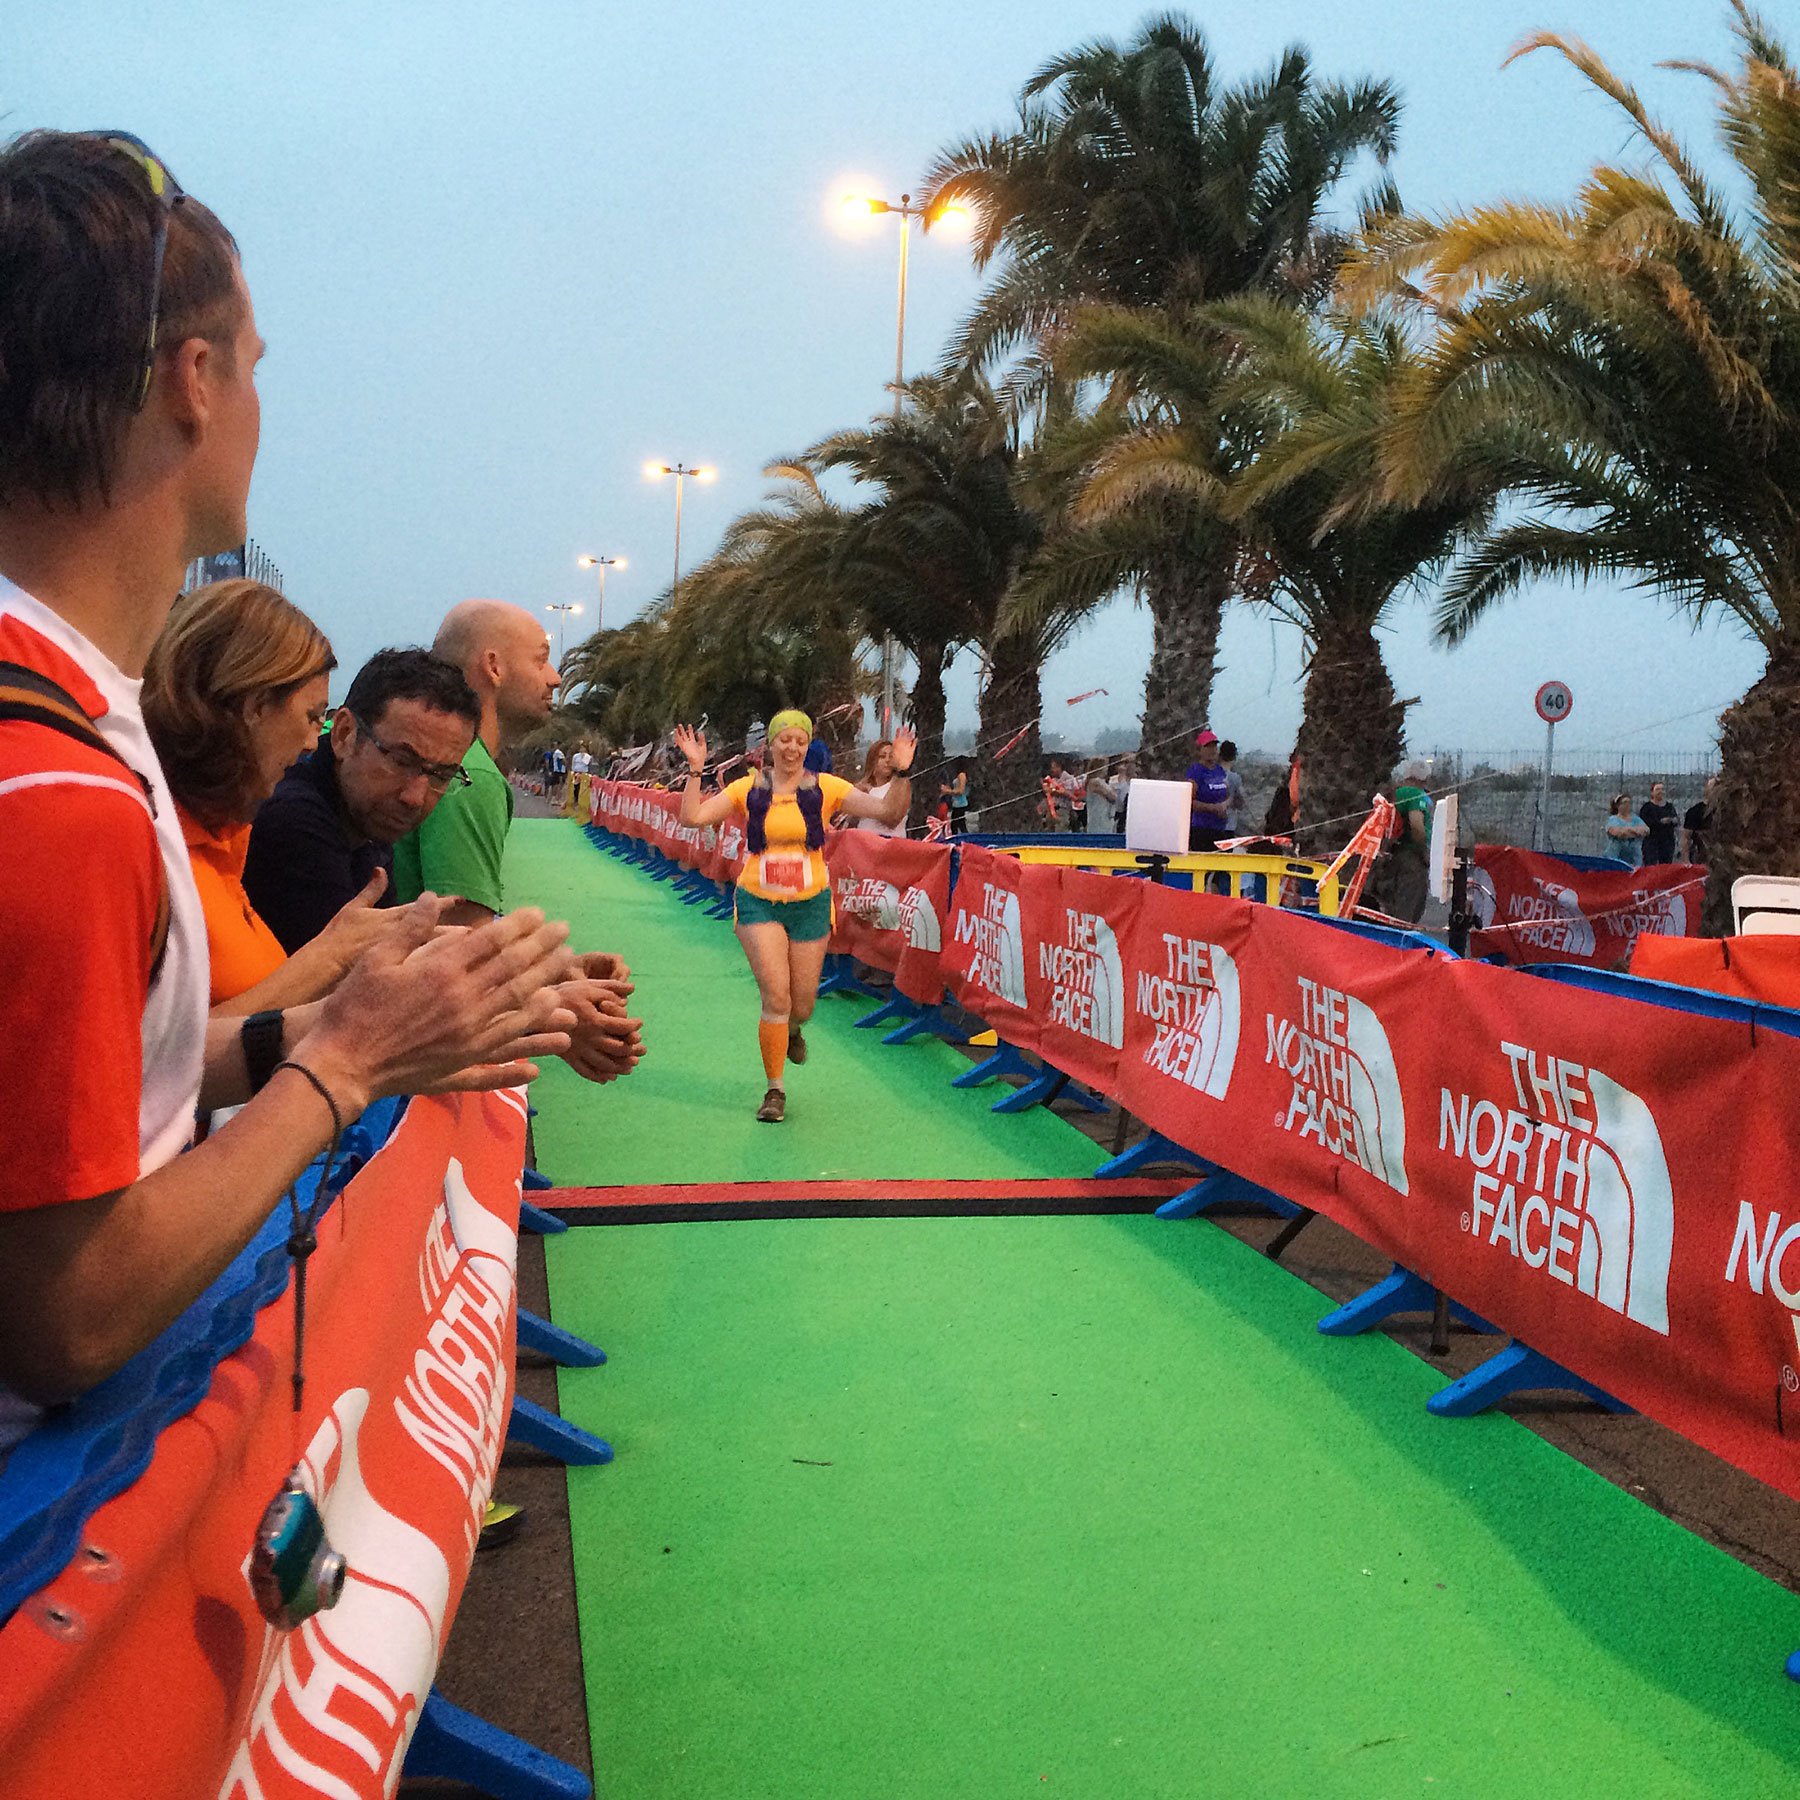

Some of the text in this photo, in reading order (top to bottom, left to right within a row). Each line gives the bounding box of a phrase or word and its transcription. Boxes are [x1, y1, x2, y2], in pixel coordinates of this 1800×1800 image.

[1546, 694, 1565, 709] 40
[861, 879, 887, 895] THE
[983, 882, 1007, 923] THE
[954, 908, 1001, 961] NORTH
[1066, 908, 1097, 953] THE
[1520, 925, 1565, 951] FACE
[967, 952, 1001, 998] FACE
[1039, 941, 1095, 995] NORTH
[1162, 933, 1212, 988] THE
[1051, 985, 1093, 1037] FACE
[1136, 970, 1213, 1034] NORTH
[1298, 975, 1346, 1048] THE
[1146, 1022, 1196, 1082] FACE
[1265, 1013, 1350, 1108] NORTH
[1500, 1040, 1593, 1134] THE
[1284, 1081, 1360, 1166] FACE
[1438, 1087, 1589, 1211] NORTH
[1472, 1171, 1580, 1288] FACE
[393, 1266, 507, 1500] NORTH
